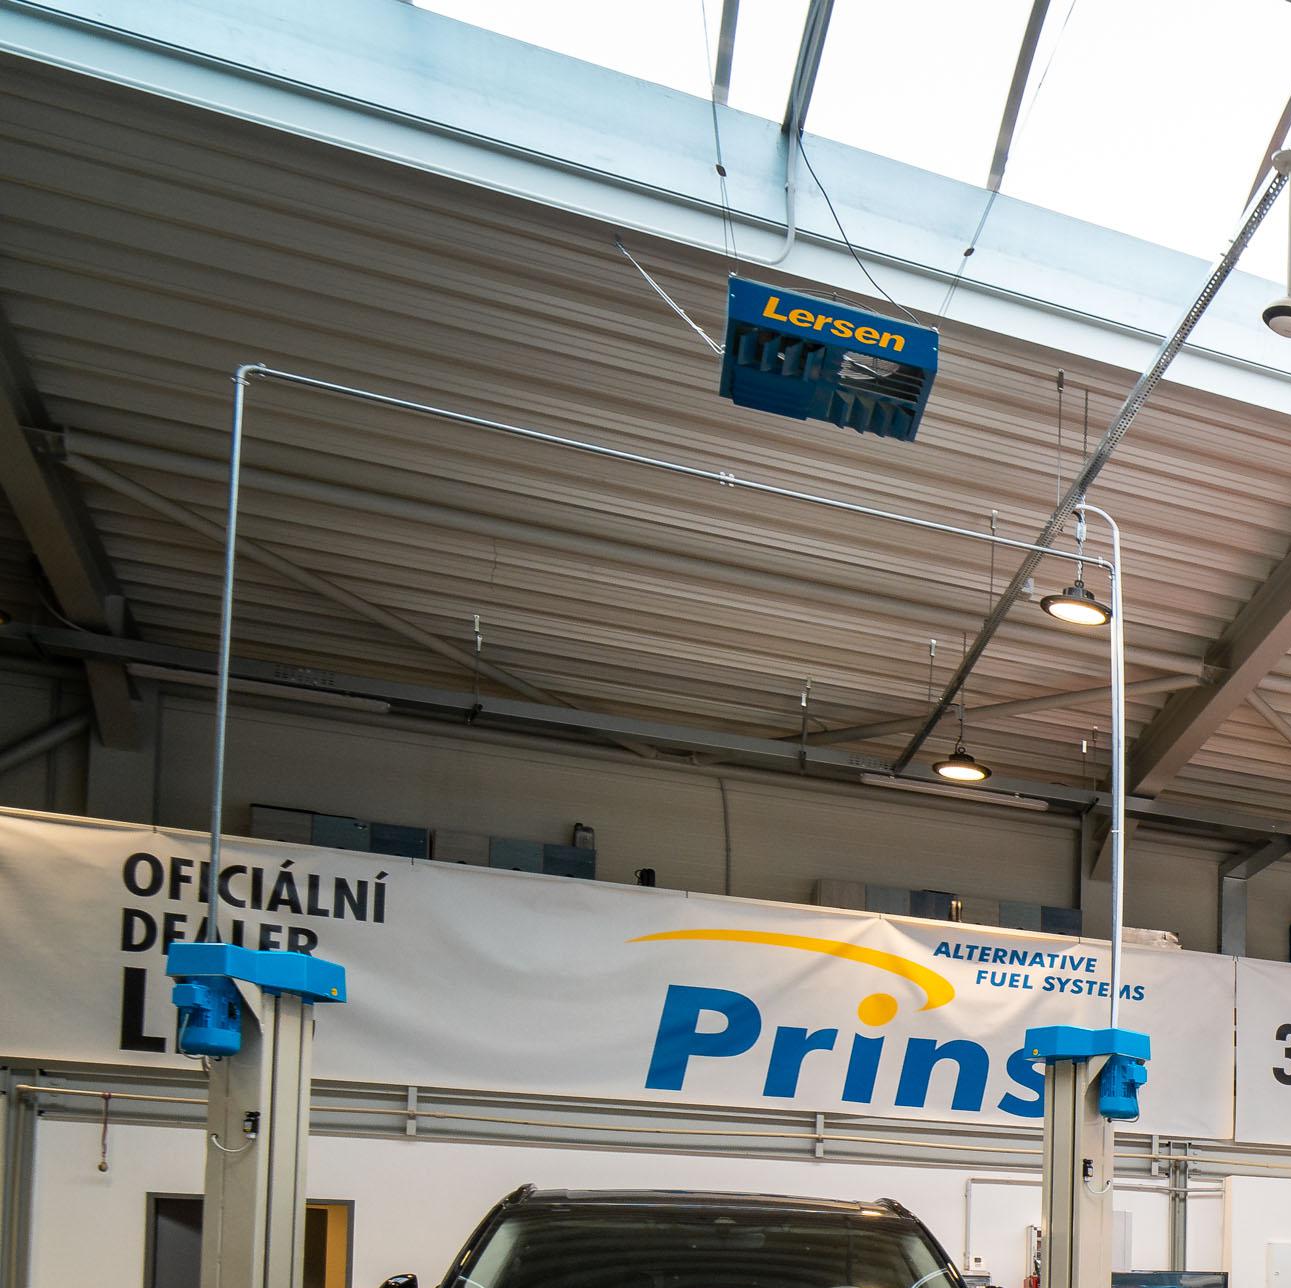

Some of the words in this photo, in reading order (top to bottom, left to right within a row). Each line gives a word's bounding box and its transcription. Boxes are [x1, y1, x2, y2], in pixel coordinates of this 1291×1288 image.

[762, 296, 906, 352] Lersen
[122, 852, 389, 924] OFICIÁLNÍ
[933, 941, 1098, 973] ALTERNATIVE
[976, 970, 1034, 990] FUEL
[645, 983, 1045, 1118] Prins
